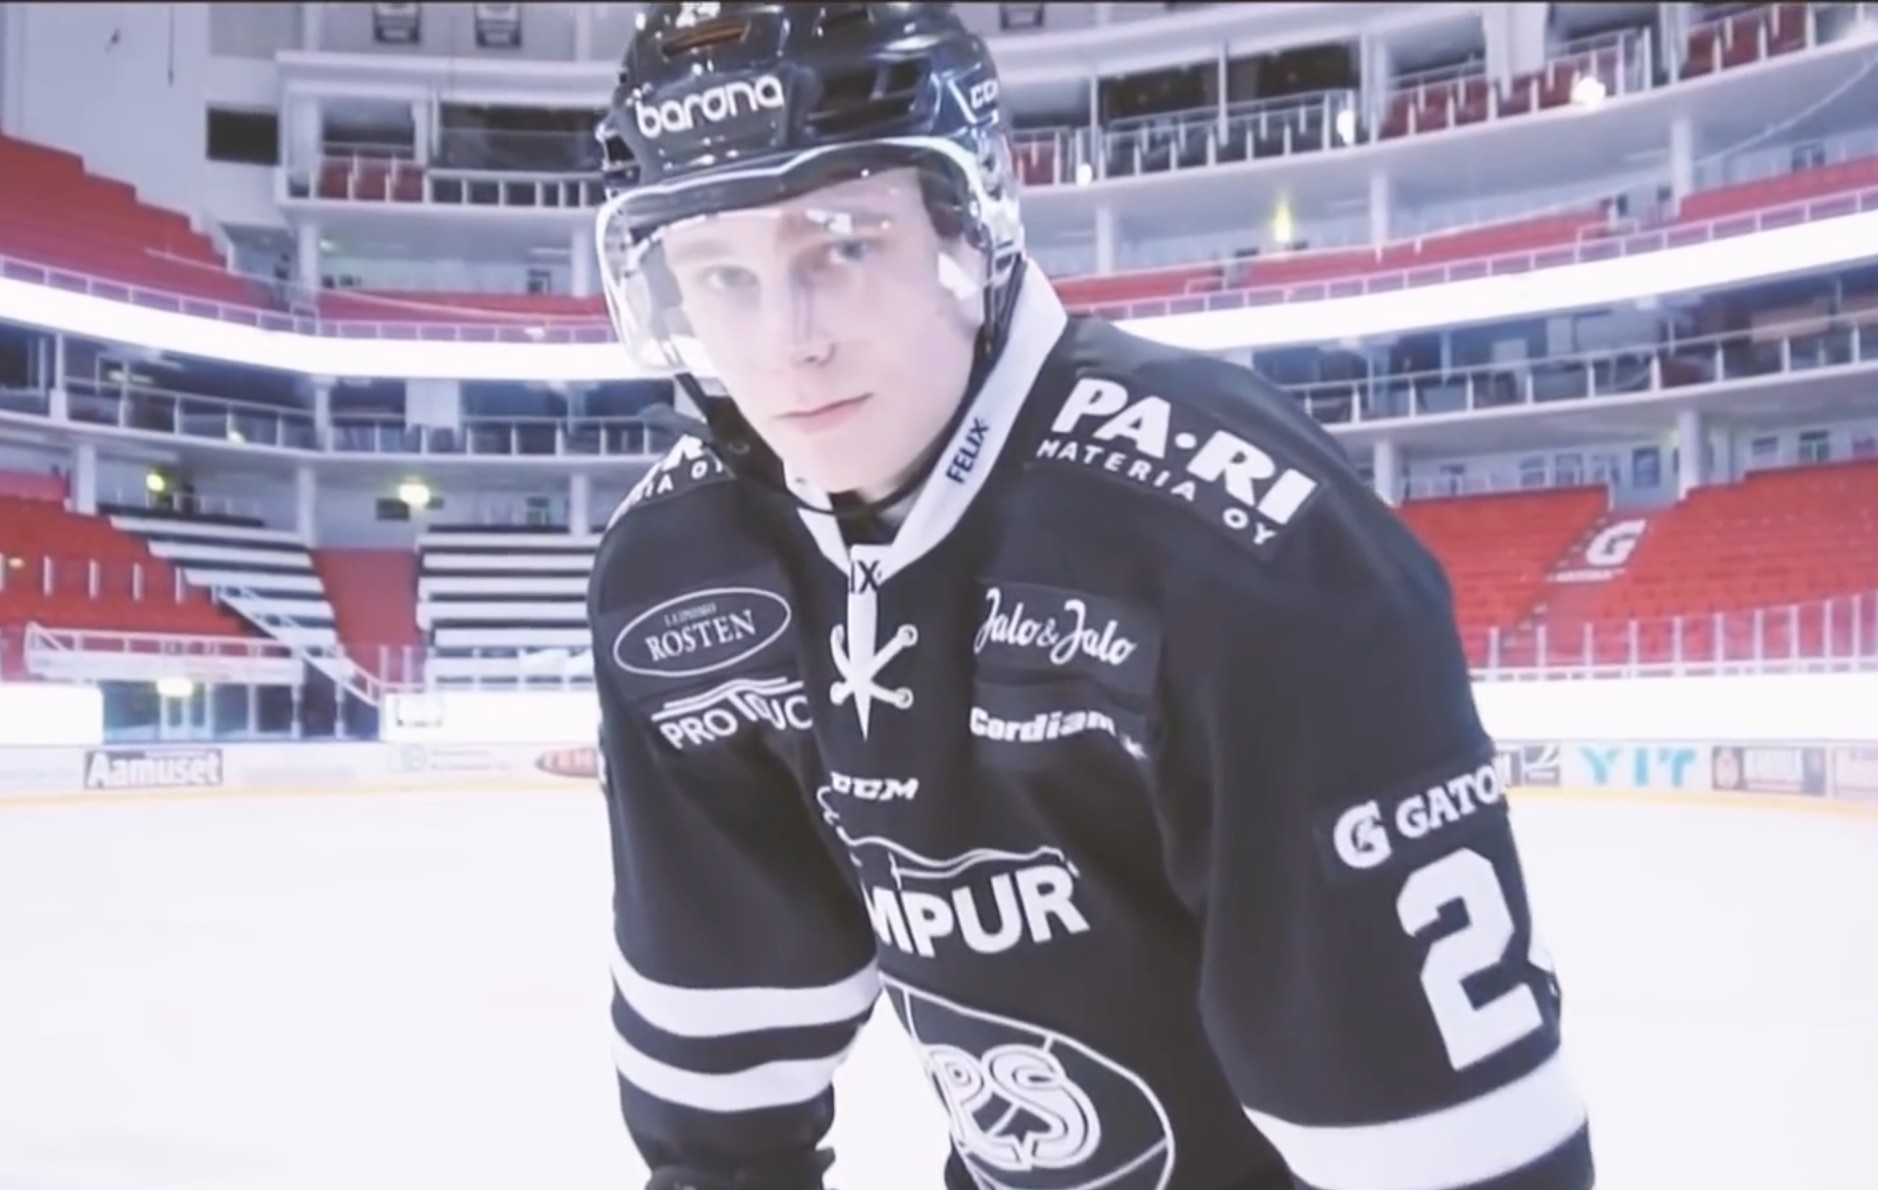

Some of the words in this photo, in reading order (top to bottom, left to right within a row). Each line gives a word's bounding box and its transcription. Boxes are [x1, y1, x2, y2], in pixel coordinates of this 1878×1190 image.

[636, 75, 785, 138] barona
[946, 417, 991, 486] FELIX
[1036, 438, 1198, 501] MATERIA
[1222, 507, 1277, 546] OY
[1586, 519, 1646, 567] G
[645, 609, 756, 662] ROSTEN
[1578, 745, 1696, 788] YIT
[1397, 847, 1556, 1072] 2
